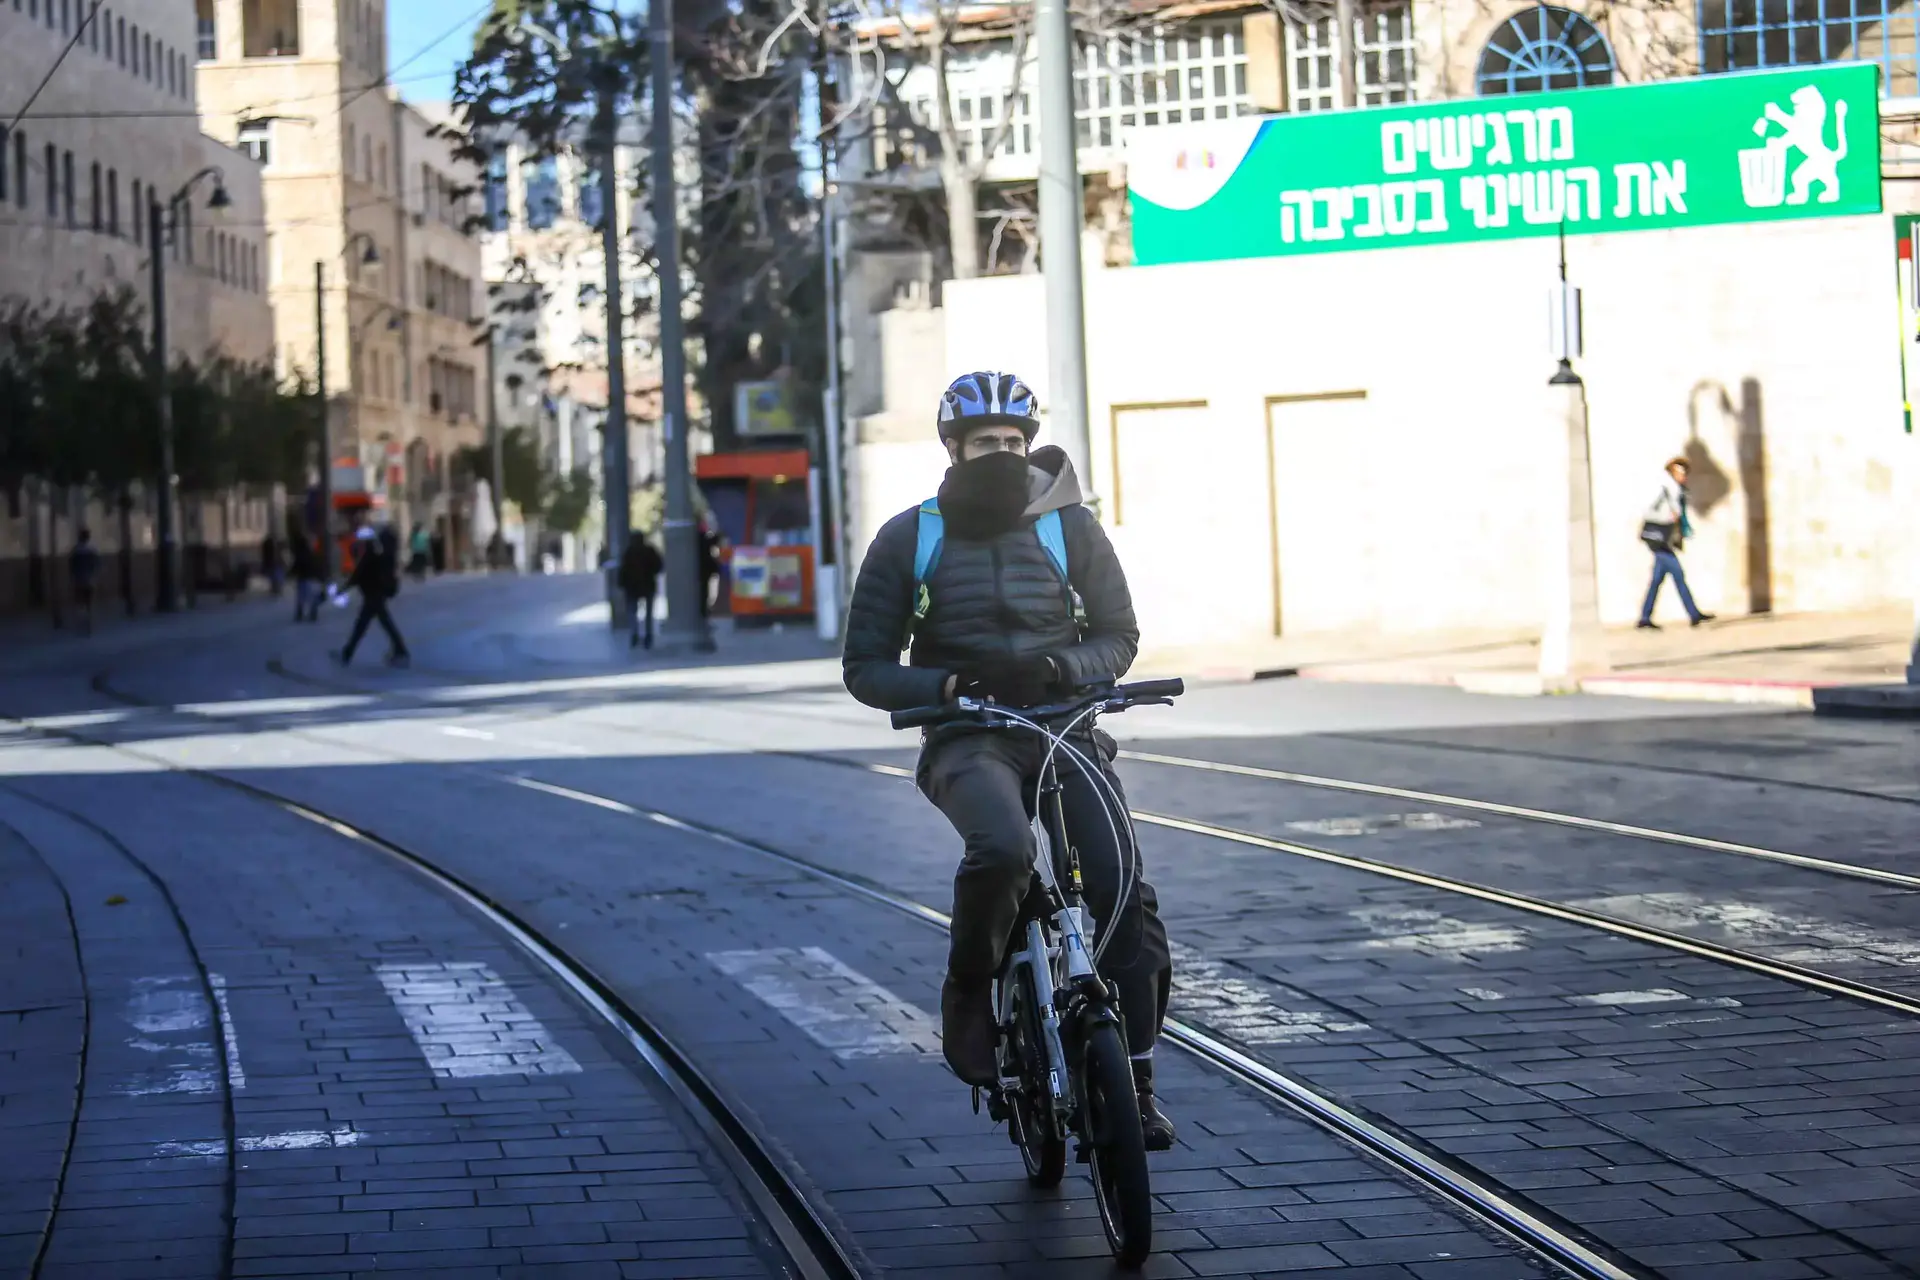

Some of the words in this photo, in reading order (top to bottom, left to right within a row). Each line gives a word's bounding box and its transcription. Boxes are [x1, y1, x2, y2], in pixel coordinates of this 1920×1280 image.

[1382, 107, 1574, 174] מרגישים
[1281, 179, 1449, 243] בסביבה
[1461, 167, 1601, 229] השינוי
[1614, 160, 1688, 219] את
